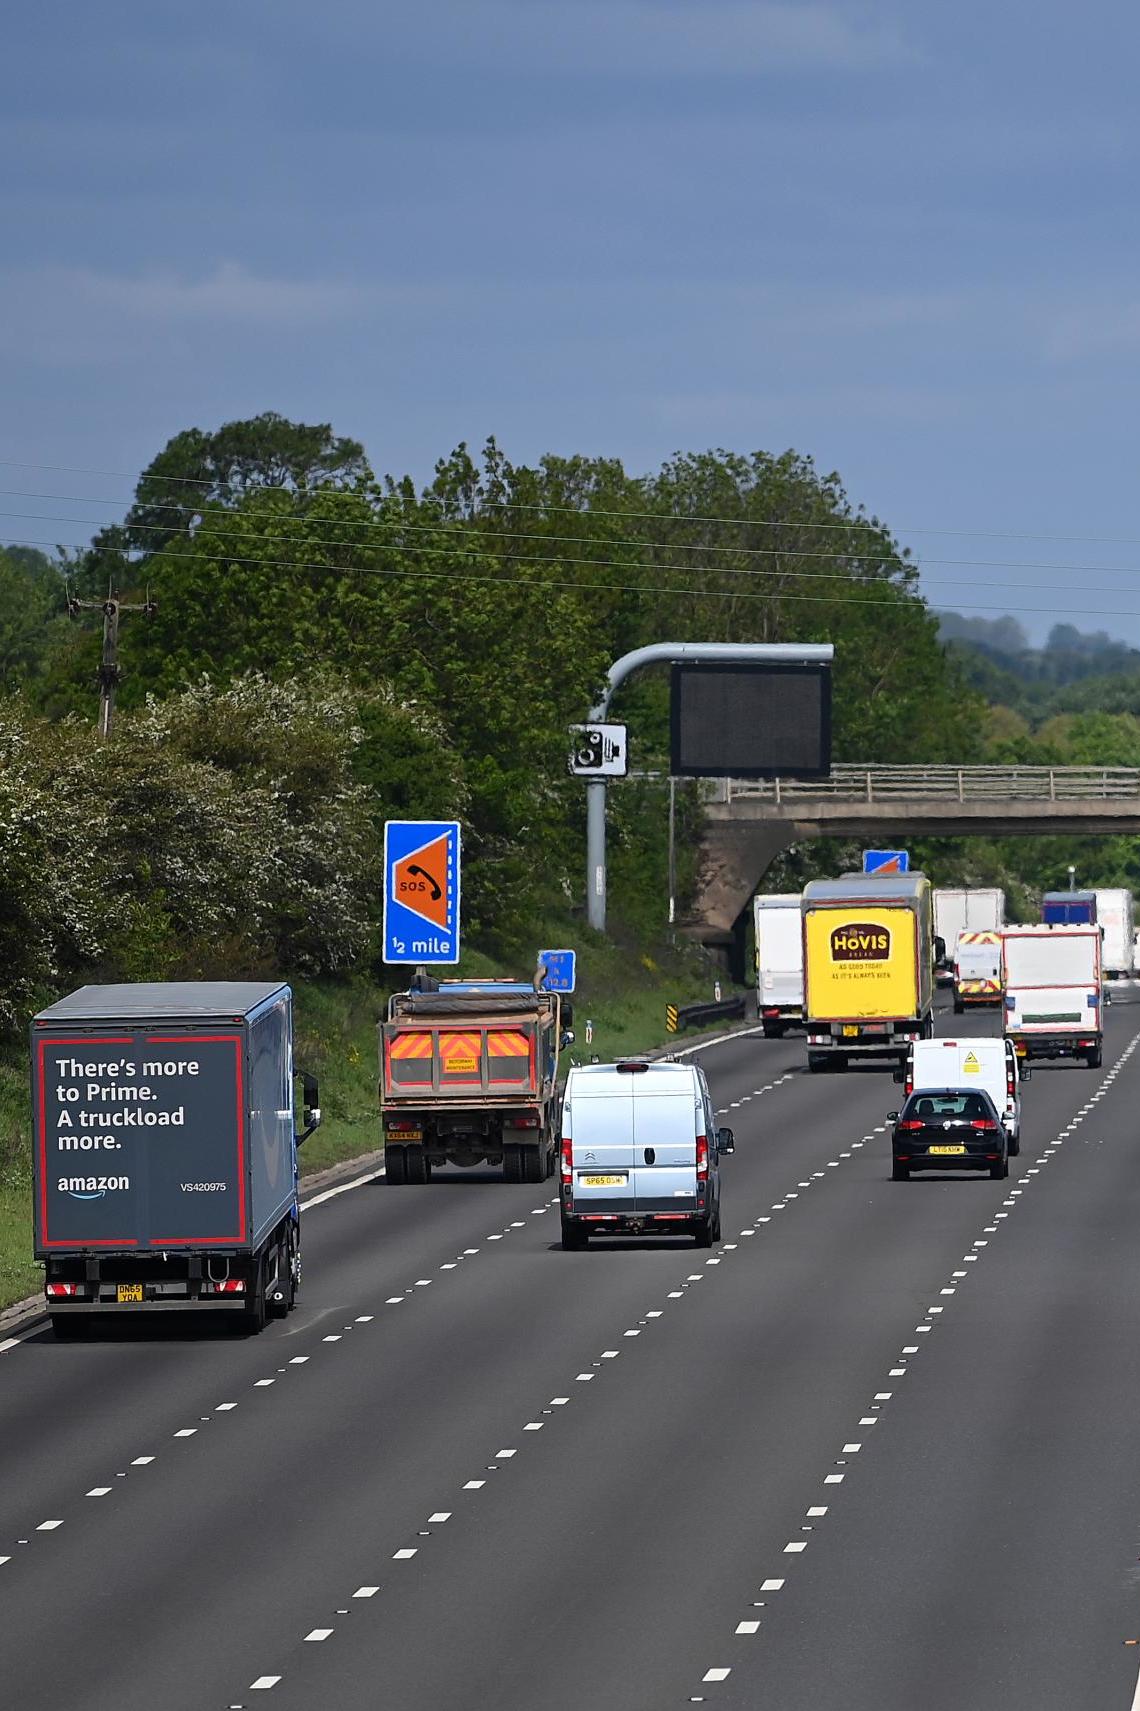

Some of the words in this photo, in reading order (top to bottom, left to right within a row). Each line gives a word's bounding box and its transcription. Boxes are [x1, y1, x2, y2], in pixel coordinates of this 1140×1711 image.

[400, 881, 426, 892] SOS
[412, 937, 450, 954] mile
[834, 934, 887, 951] HOVIS
[55, 1058, 136, 1078] There's
[142, 1060, 199, 1077] more
[56, 1084, 80, 1102] to
[87, 1081, 158, 1101] Prime.
[57, 1109, 73, 1128] A
[79, 1106, 185, 1127] truckload
[58, 1134, 122, 1151] more.
[57, 1175, 130, 1192] amazon
[180, 1182, 227, 1192] VS420975
[586, 1177, 605, 1185] SP65
